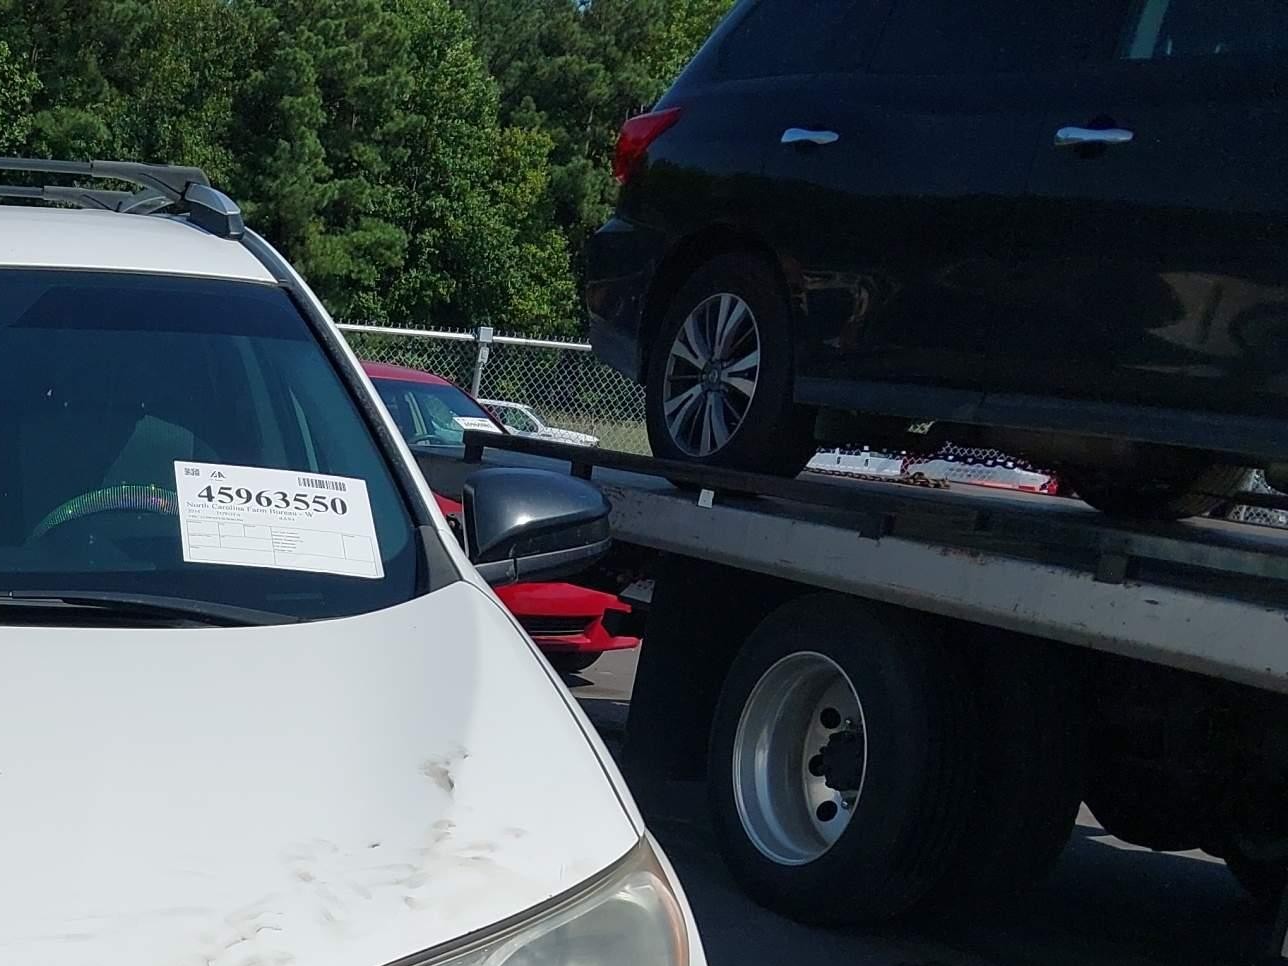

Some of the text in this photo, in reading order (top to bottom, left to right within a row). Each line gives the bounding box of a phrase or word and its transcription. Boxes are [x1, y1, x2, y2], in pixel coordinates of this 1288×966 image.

[198, 485, 347, 515] 45963550
[212, 503, 245, 511] Carolina
[269, 508, 297, 516] Bureau
